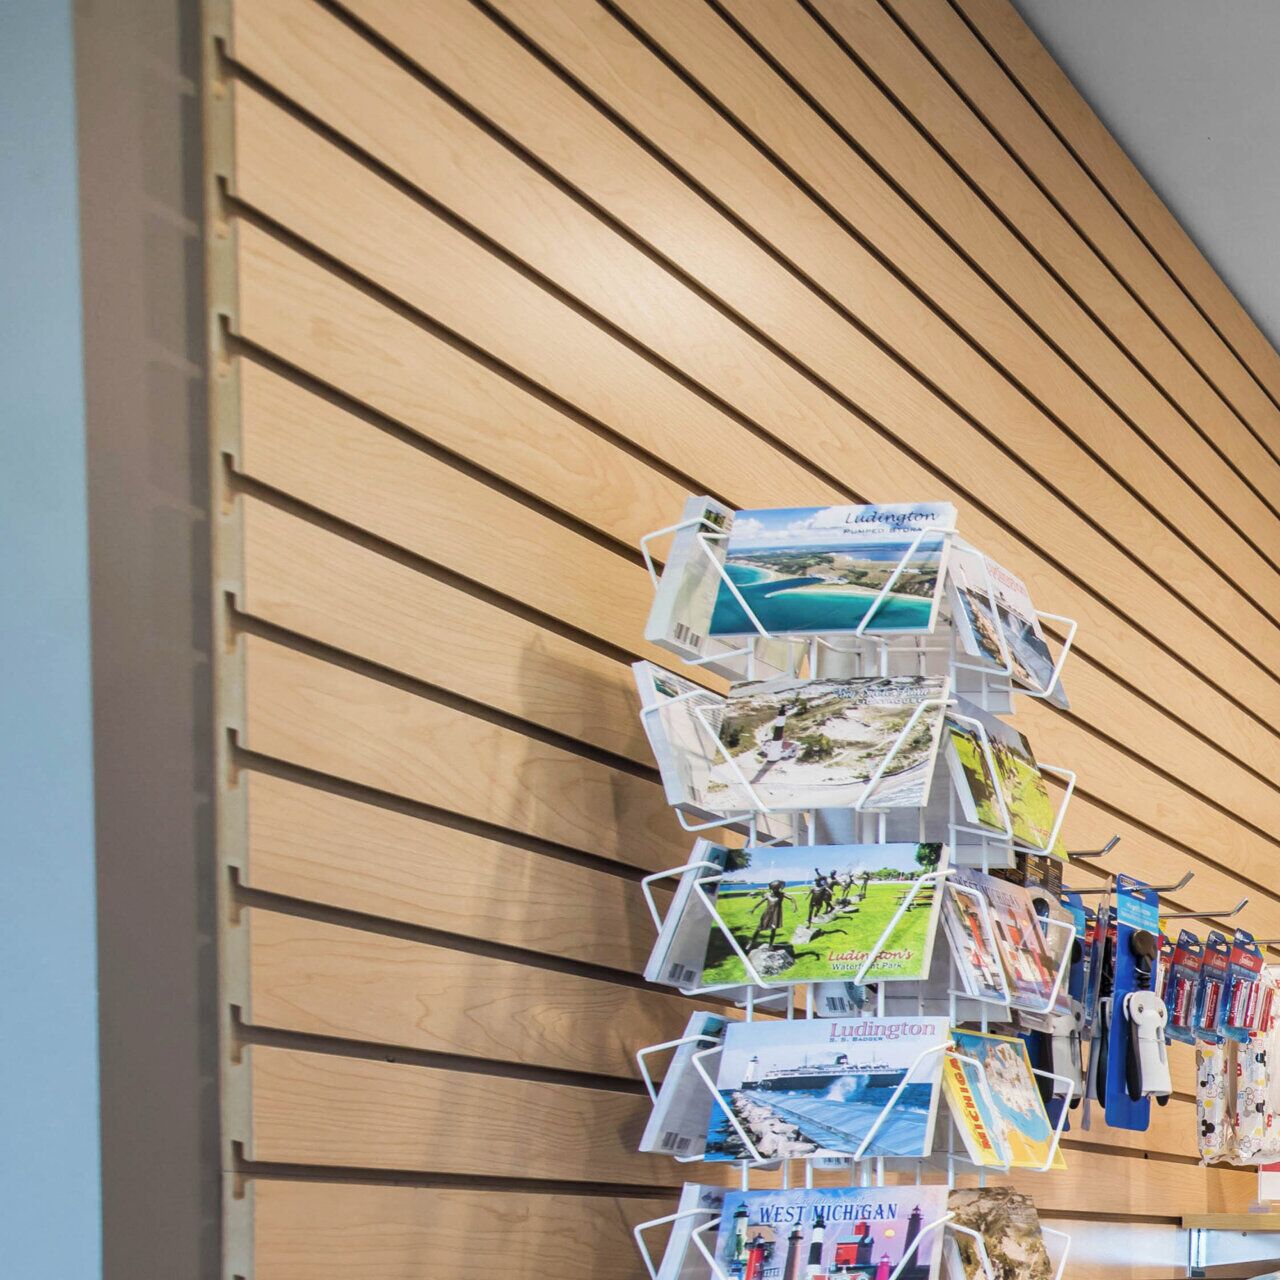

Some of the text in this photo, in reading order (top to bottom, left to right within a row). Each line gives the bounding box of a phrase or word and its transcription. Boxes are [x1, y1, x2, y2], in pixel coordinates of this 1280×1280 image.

[845, 511, 939, 526] Ludington
[828, 948, 914, 963] Ludinton's
[830, 1021, 936, 1040] Ludington
[759, 1202, 898, 1223] WEST MICHIGAN
